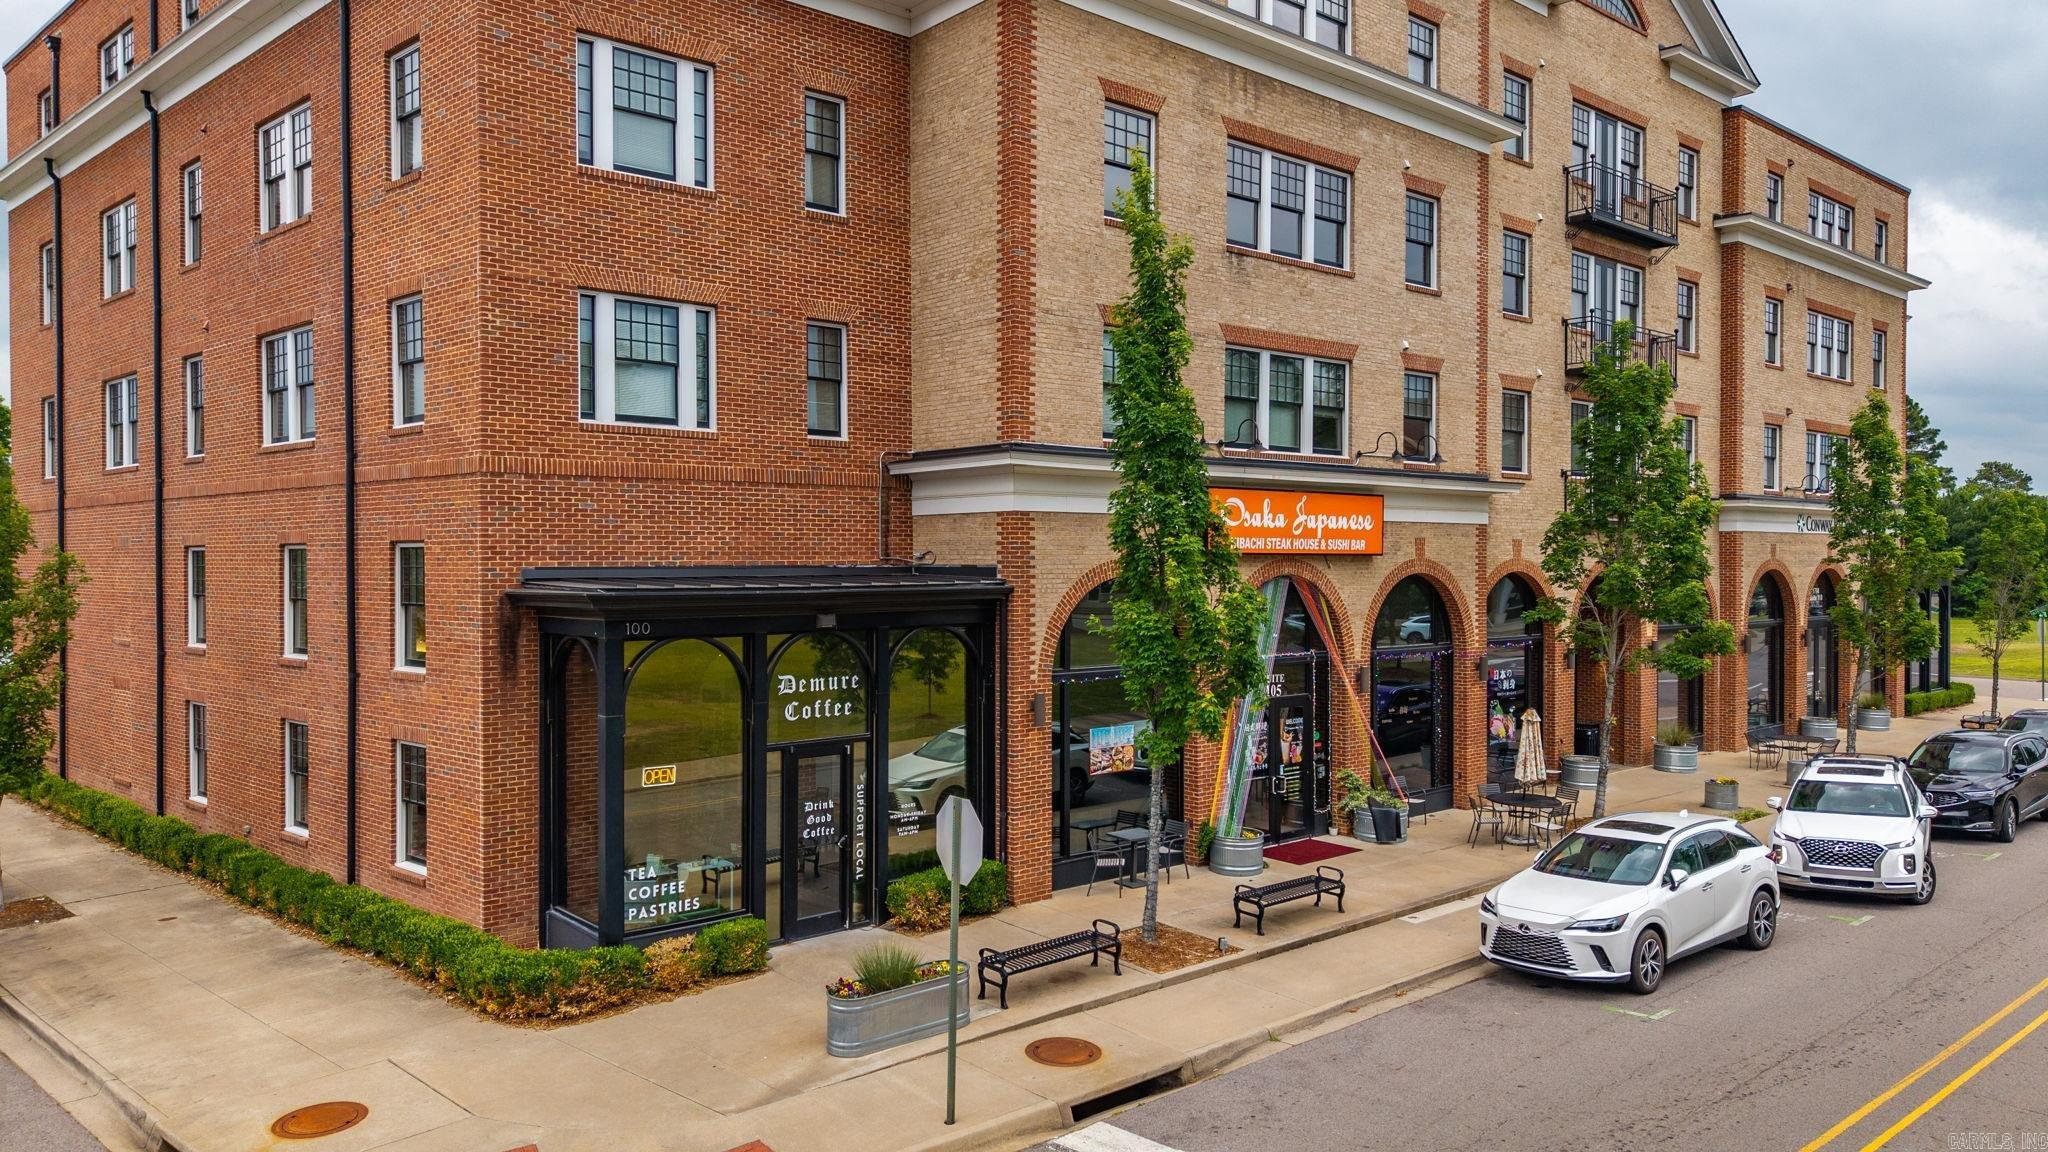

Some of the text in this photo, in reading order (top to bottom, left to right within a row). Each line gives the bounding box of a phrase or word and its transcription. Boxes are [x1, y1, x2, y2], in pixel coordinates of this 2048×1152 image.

[1219, 495, 1374, 538] Osaka Japanese
[1266, 537, 1291, 550] STEAK
[1293, 538, 1319, 550] HOUSE
[1321, 538, 1326, 550] &
[1328, 539, 1349, 550] SUSHI
[1351, 539, 1366, 551] BAR
[625, 622, 651, 635] 100
[777, 675, 859, 696] Demure
[1266, 684, 1282, 697] 105
[784, 699, 852, 721] Coffee
[644, 768, 676, 785] OPEN
[804, 799, 834, 813] Drink
[806, 813, 832, 825] Good
[803, 826, 835, 839] Coffee
[856, 784, 865, 880] SUPPORT LOCAL
[628, 866, 657, 881] TEA
[628, 880, 685, 901] COFFEE
[628, 897, 700, 921] PASTRIES
